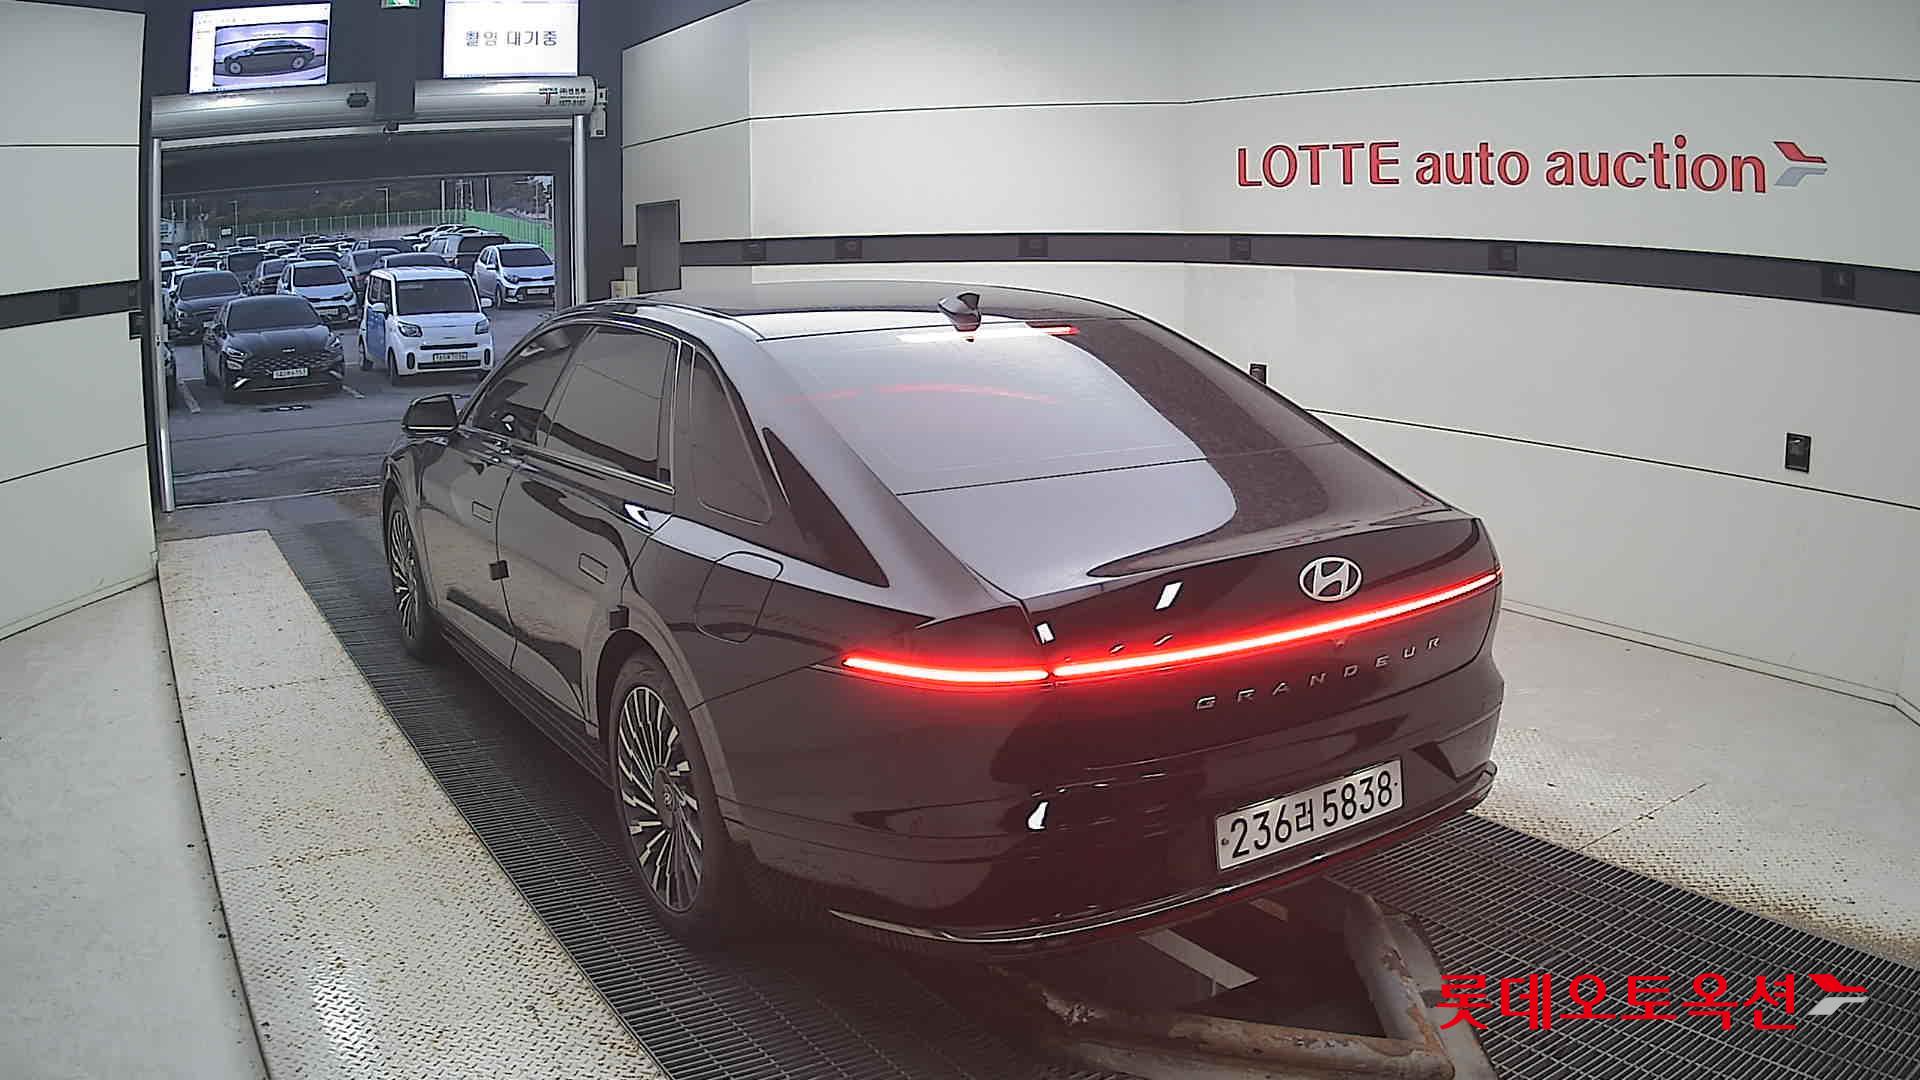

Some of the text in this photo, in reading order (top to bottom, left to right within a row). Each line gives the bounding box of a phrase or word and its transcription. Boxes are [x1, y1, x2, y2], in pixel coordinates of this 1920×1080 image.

[506, 30, 558, 47] 대기중
[1236, 134, 1766, 194] LOTTE auto auction
[1195, 635, 1441, 711] GRANDEUR
[1229, 770, 1393, 859] 236러 5838
